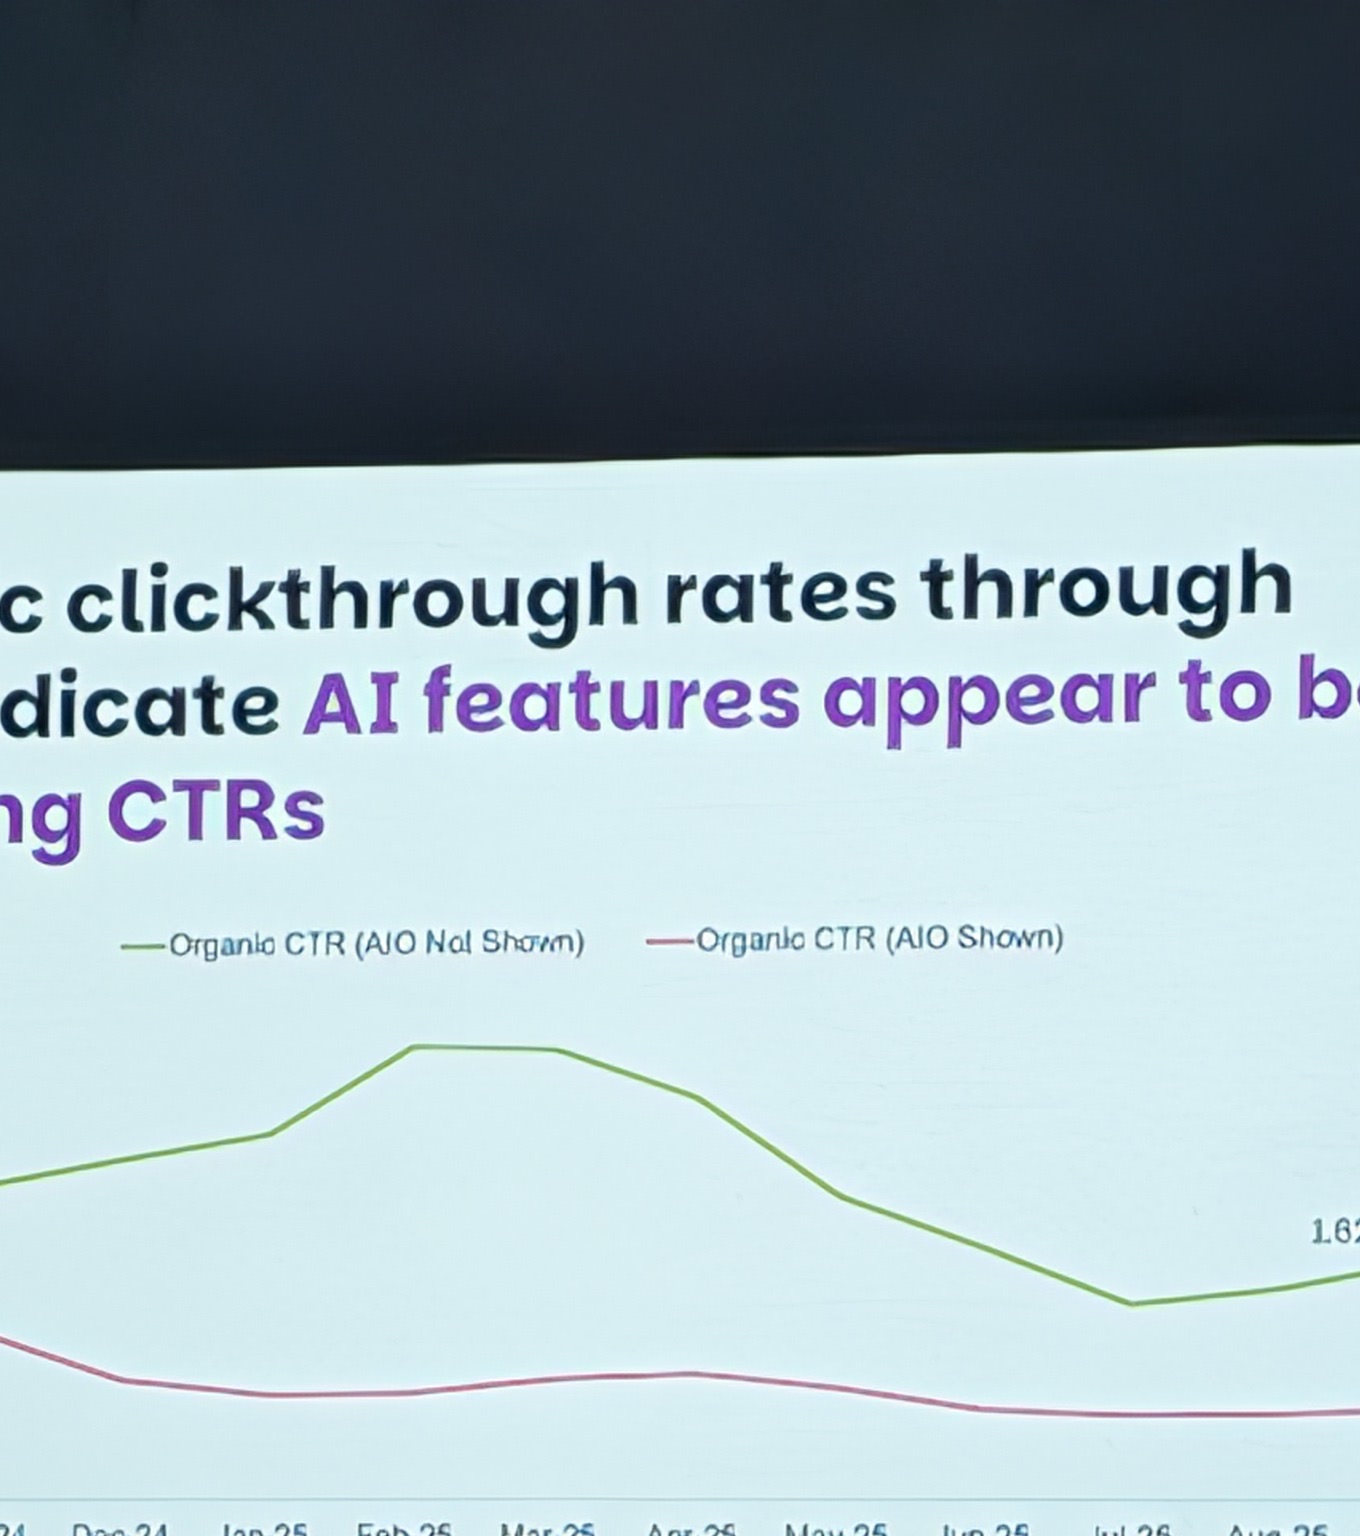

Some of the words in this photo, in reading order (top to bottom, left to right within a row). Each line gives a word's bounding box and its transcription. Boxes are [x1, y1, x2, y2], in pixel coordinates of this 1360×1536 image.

[67, 561, 638, 649] clickthrough
[667, 562, 896, 623] rates
[920, 547, 1291, 639] through
[303, 672, 399, 734] AI
[424, 664, 799, 733] features
[824, 672, 1156, 750] appear
[1179, 659, 1271, 722] to
[109, 779, 324, 842] CTRs
[169, 931, 275, 962] Organic
[285, 931, 345, 956] CTR
[355, 929, 416, 961] (AIO
[426, 929, 471, 955] Not
[482, 928, 585, 959] Shown)
[697, 927, 805, 958] Organic
[815, 926, 875, 951] CTR
[887, 925, 949, 957] (AIO
[958, 924, 1064, 955] Shown)
